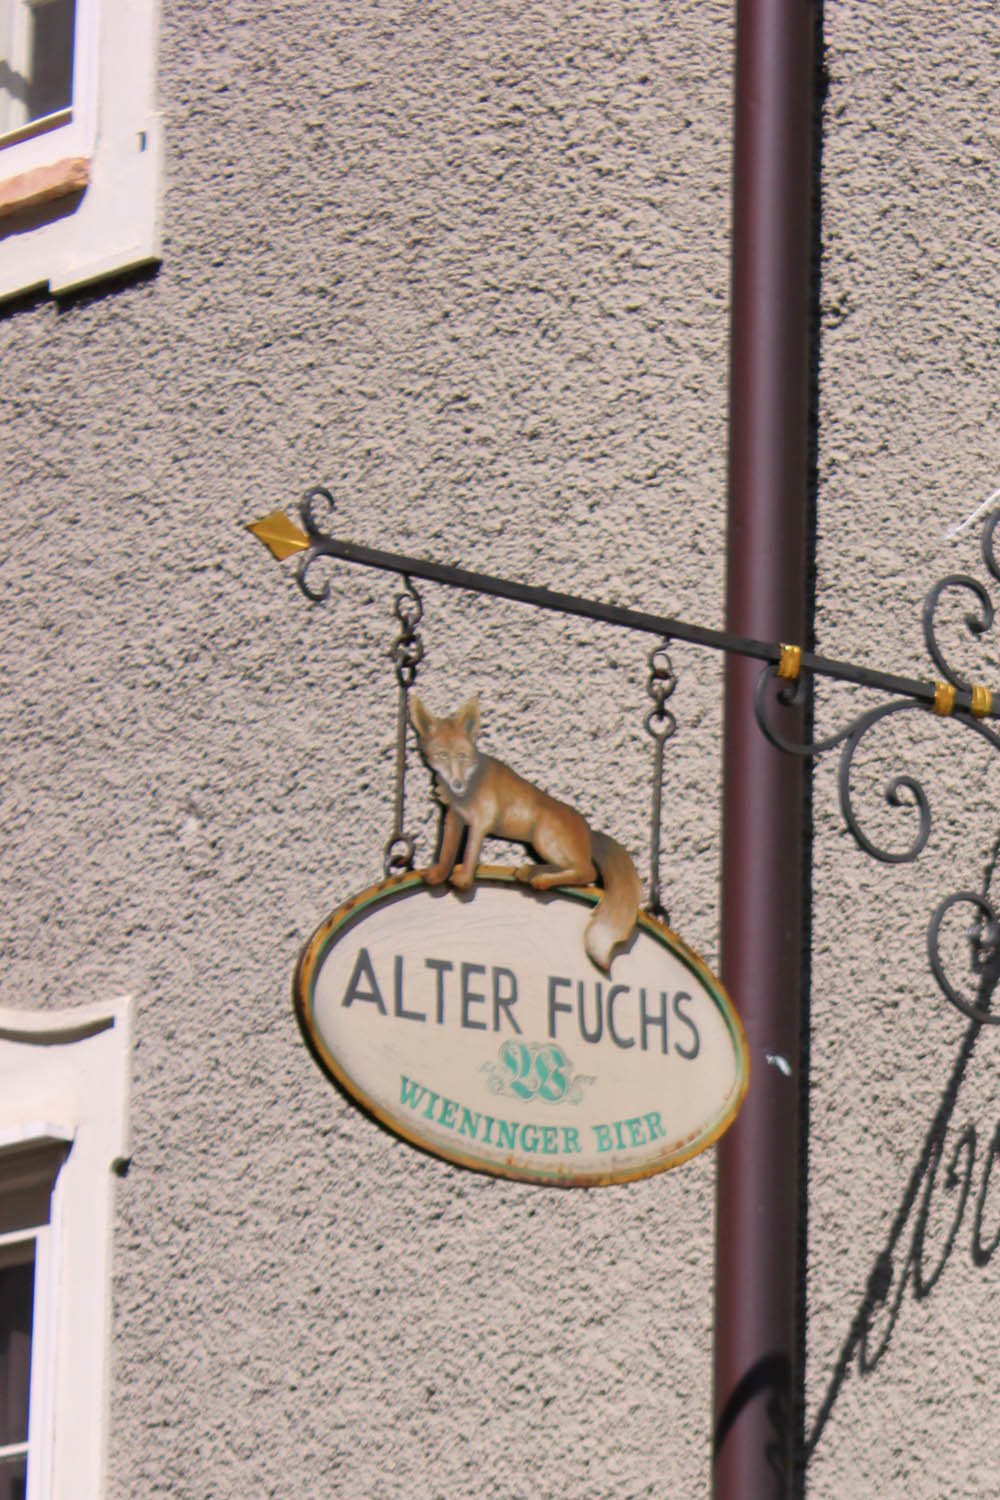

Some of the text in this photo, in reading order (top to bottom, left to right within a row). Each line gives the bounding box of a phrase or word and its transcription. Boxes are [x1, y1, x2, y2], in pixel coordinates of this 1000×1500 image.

[341, 948, 701, 1060] ALTER FUCHS
[399, 1076, 667, 1154] WIENINGER BIER
